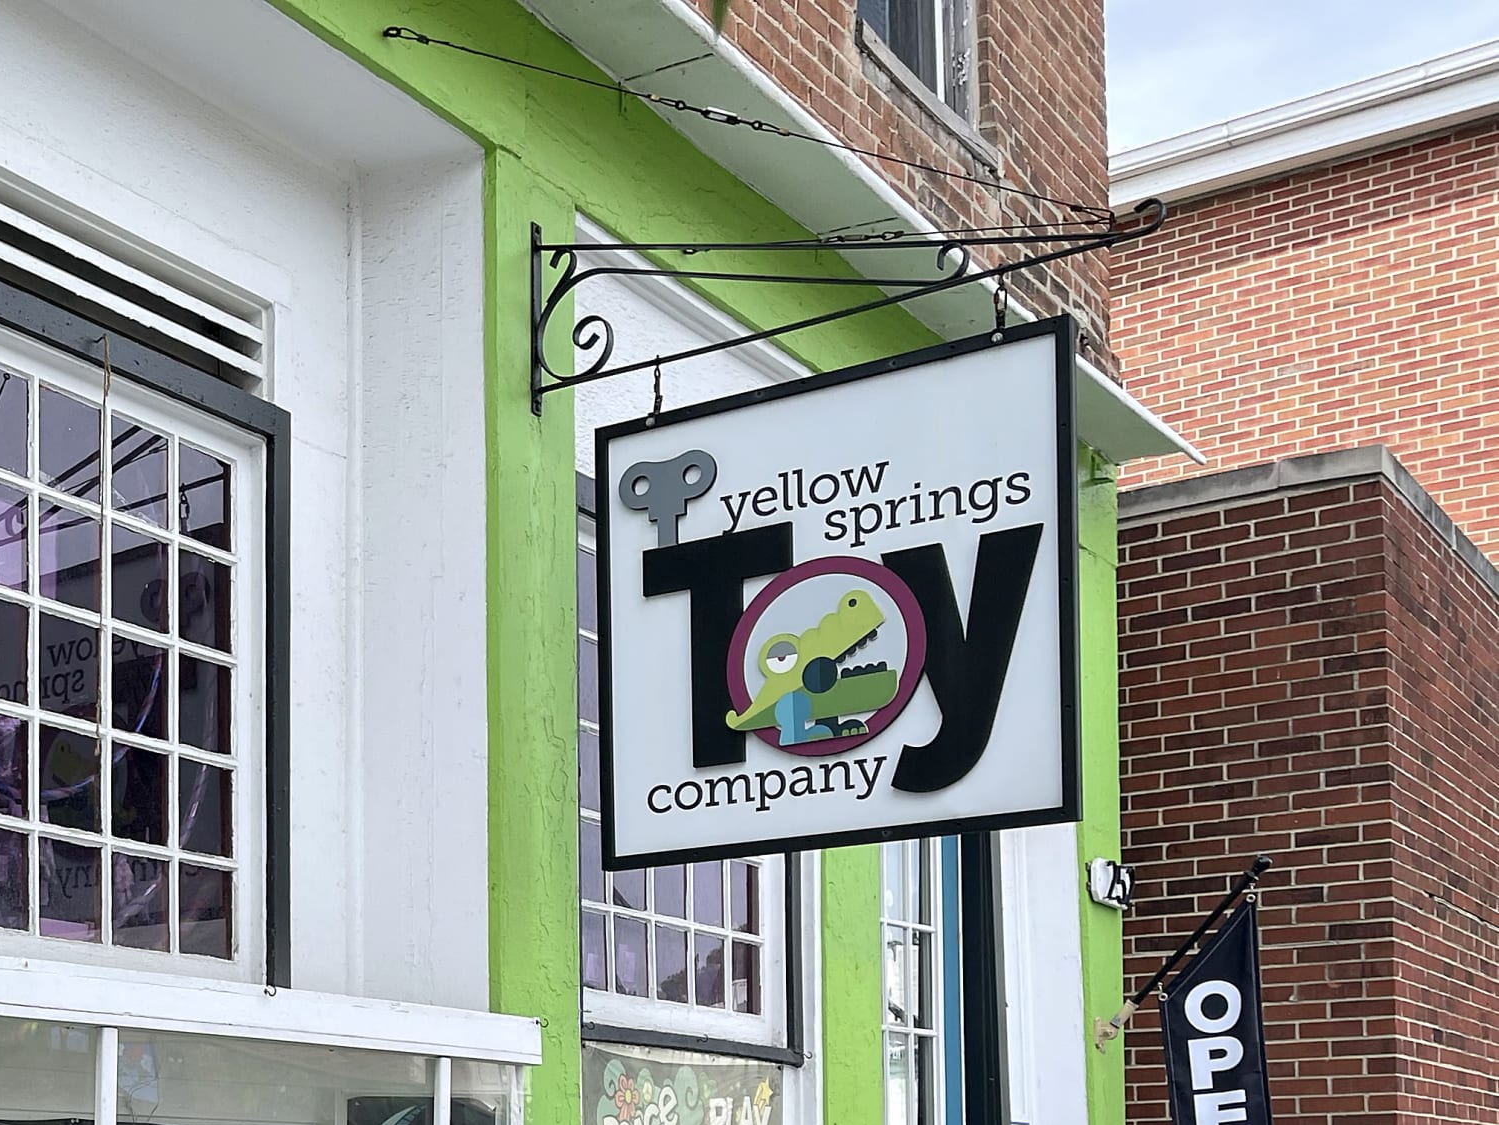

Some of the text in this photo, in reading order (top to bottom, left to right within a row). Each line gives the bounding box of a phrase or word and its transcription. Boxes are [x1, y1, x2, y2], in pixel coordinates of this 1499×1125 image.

[720, 461, 890, 535] yellow
[824, 471, 1032, 548] springs
[647, 753, 888, 814] company
